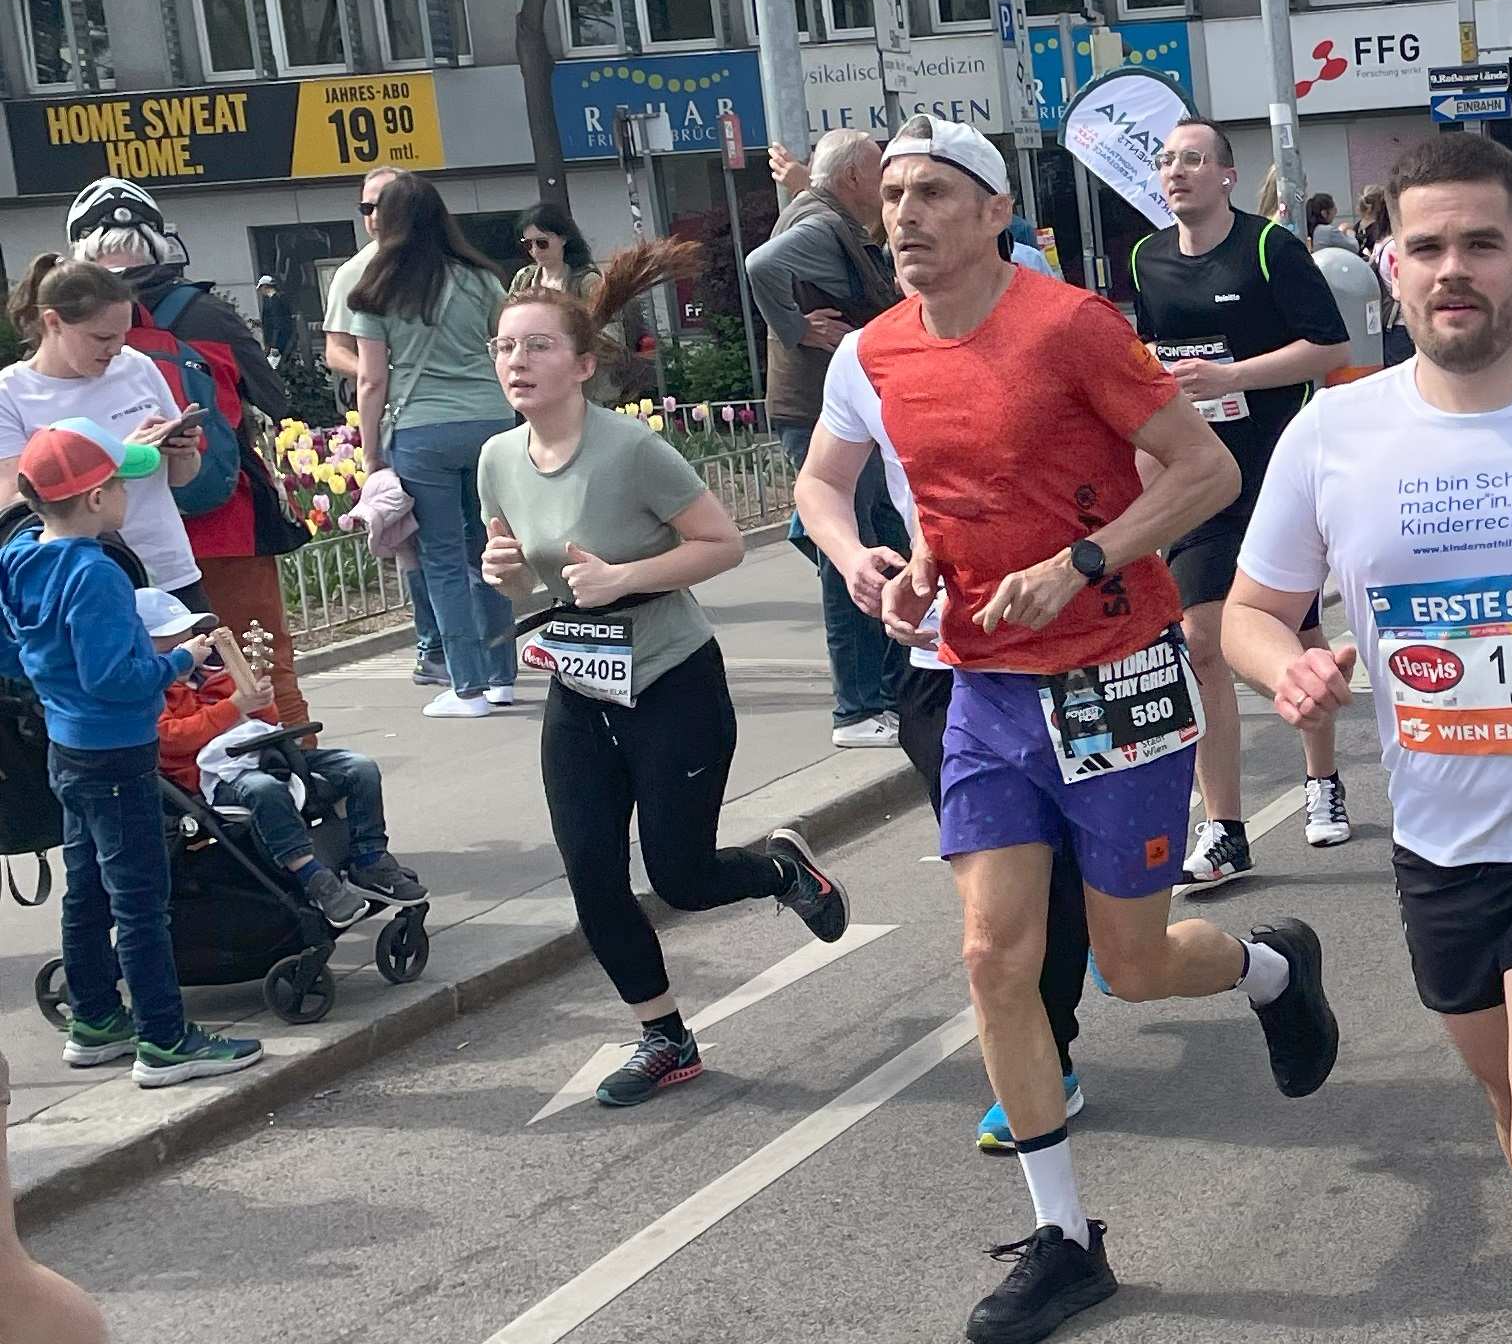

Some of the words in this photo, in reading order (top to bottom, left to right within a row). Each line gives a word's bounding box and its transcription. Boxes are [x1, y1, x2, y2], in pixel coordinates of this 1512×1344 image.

[1000, 6, 1012, 38] P
[1354, 33, 1420, 66] FFG
[1356, 67, 1400, 79] Forschung
[1400, 67, 1423, 77] wirkt
[1480, 70, 1509, 80] Lände
[324, 83, 410, 104] JAHRES-ABO
[1456, 99, 1502, 113] EINBAHN
[47, 102, 136, 145] HOME
[142, 93, 249, 138] SWEAT
[327, 106, 379, 164] 19
[383, 105, 415, 135] 90
[105, 136, 205, 179] HOME.
[389, 144, 420, 161] mtl.
[1398, 478, 1429, 495] Ich
[1436, 476, 1469, 492] bin
[1410, 591, 1501, 623] ERSTE
[546, 621, 625, 640] ERADE
[561, 656, 627, 681] 2240B
[1098, 641, 1175, 683] HYDRATE
[1394, 656, 1459, 684] Hervis
[1104, 677, 1139, 702] STAY
[1139, 663, 1179, 693] GREAT
[1131, 696, 1174, 728] 580
[1437, 724, 1489, 741] WIEN
[1142, 744, 1168, 758] Wien
